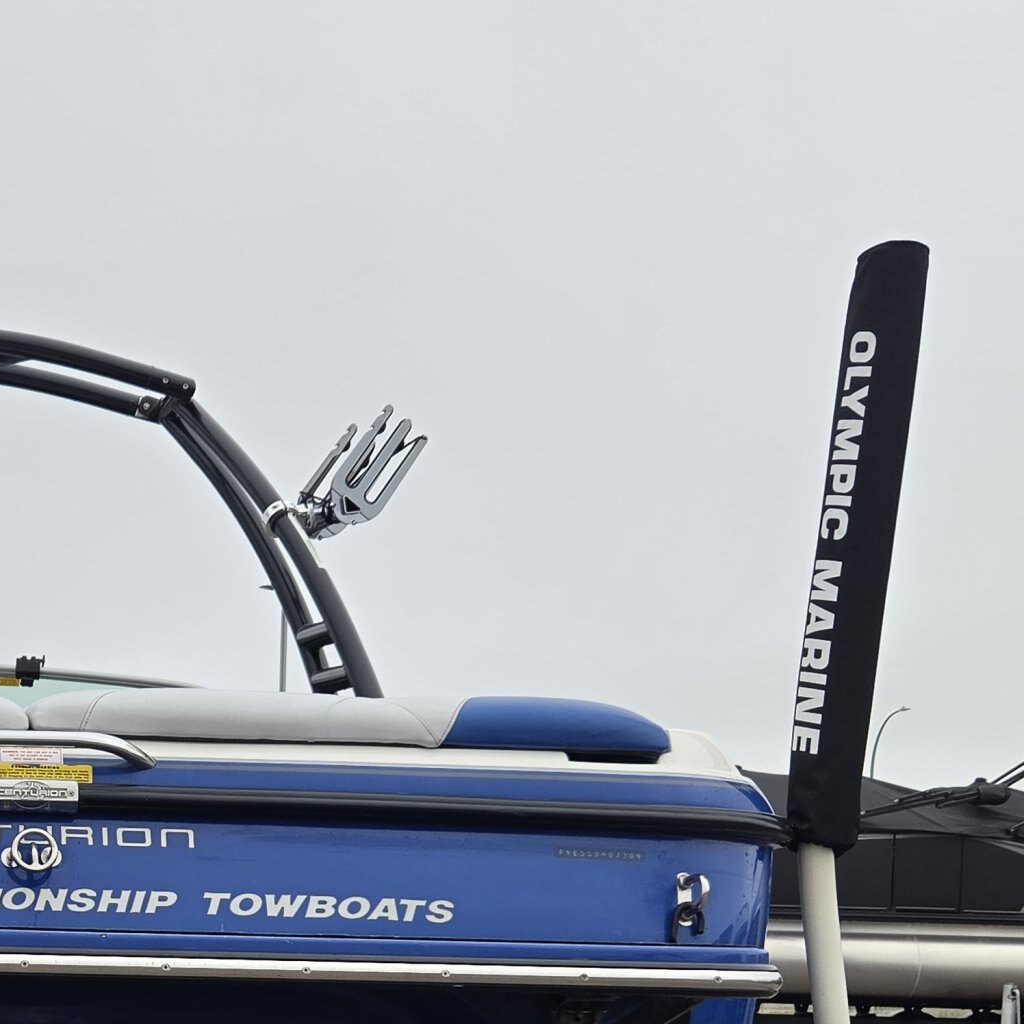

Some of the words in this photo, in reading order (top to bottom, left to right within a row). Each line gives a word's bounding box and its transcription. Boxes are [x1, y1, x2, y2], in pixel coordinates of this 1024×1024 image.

[820, 331, 877, 541] OLYMPIC
[791, 560, 843, 755] MARINE
[203, 891, 455, 924] TOWBOATS
